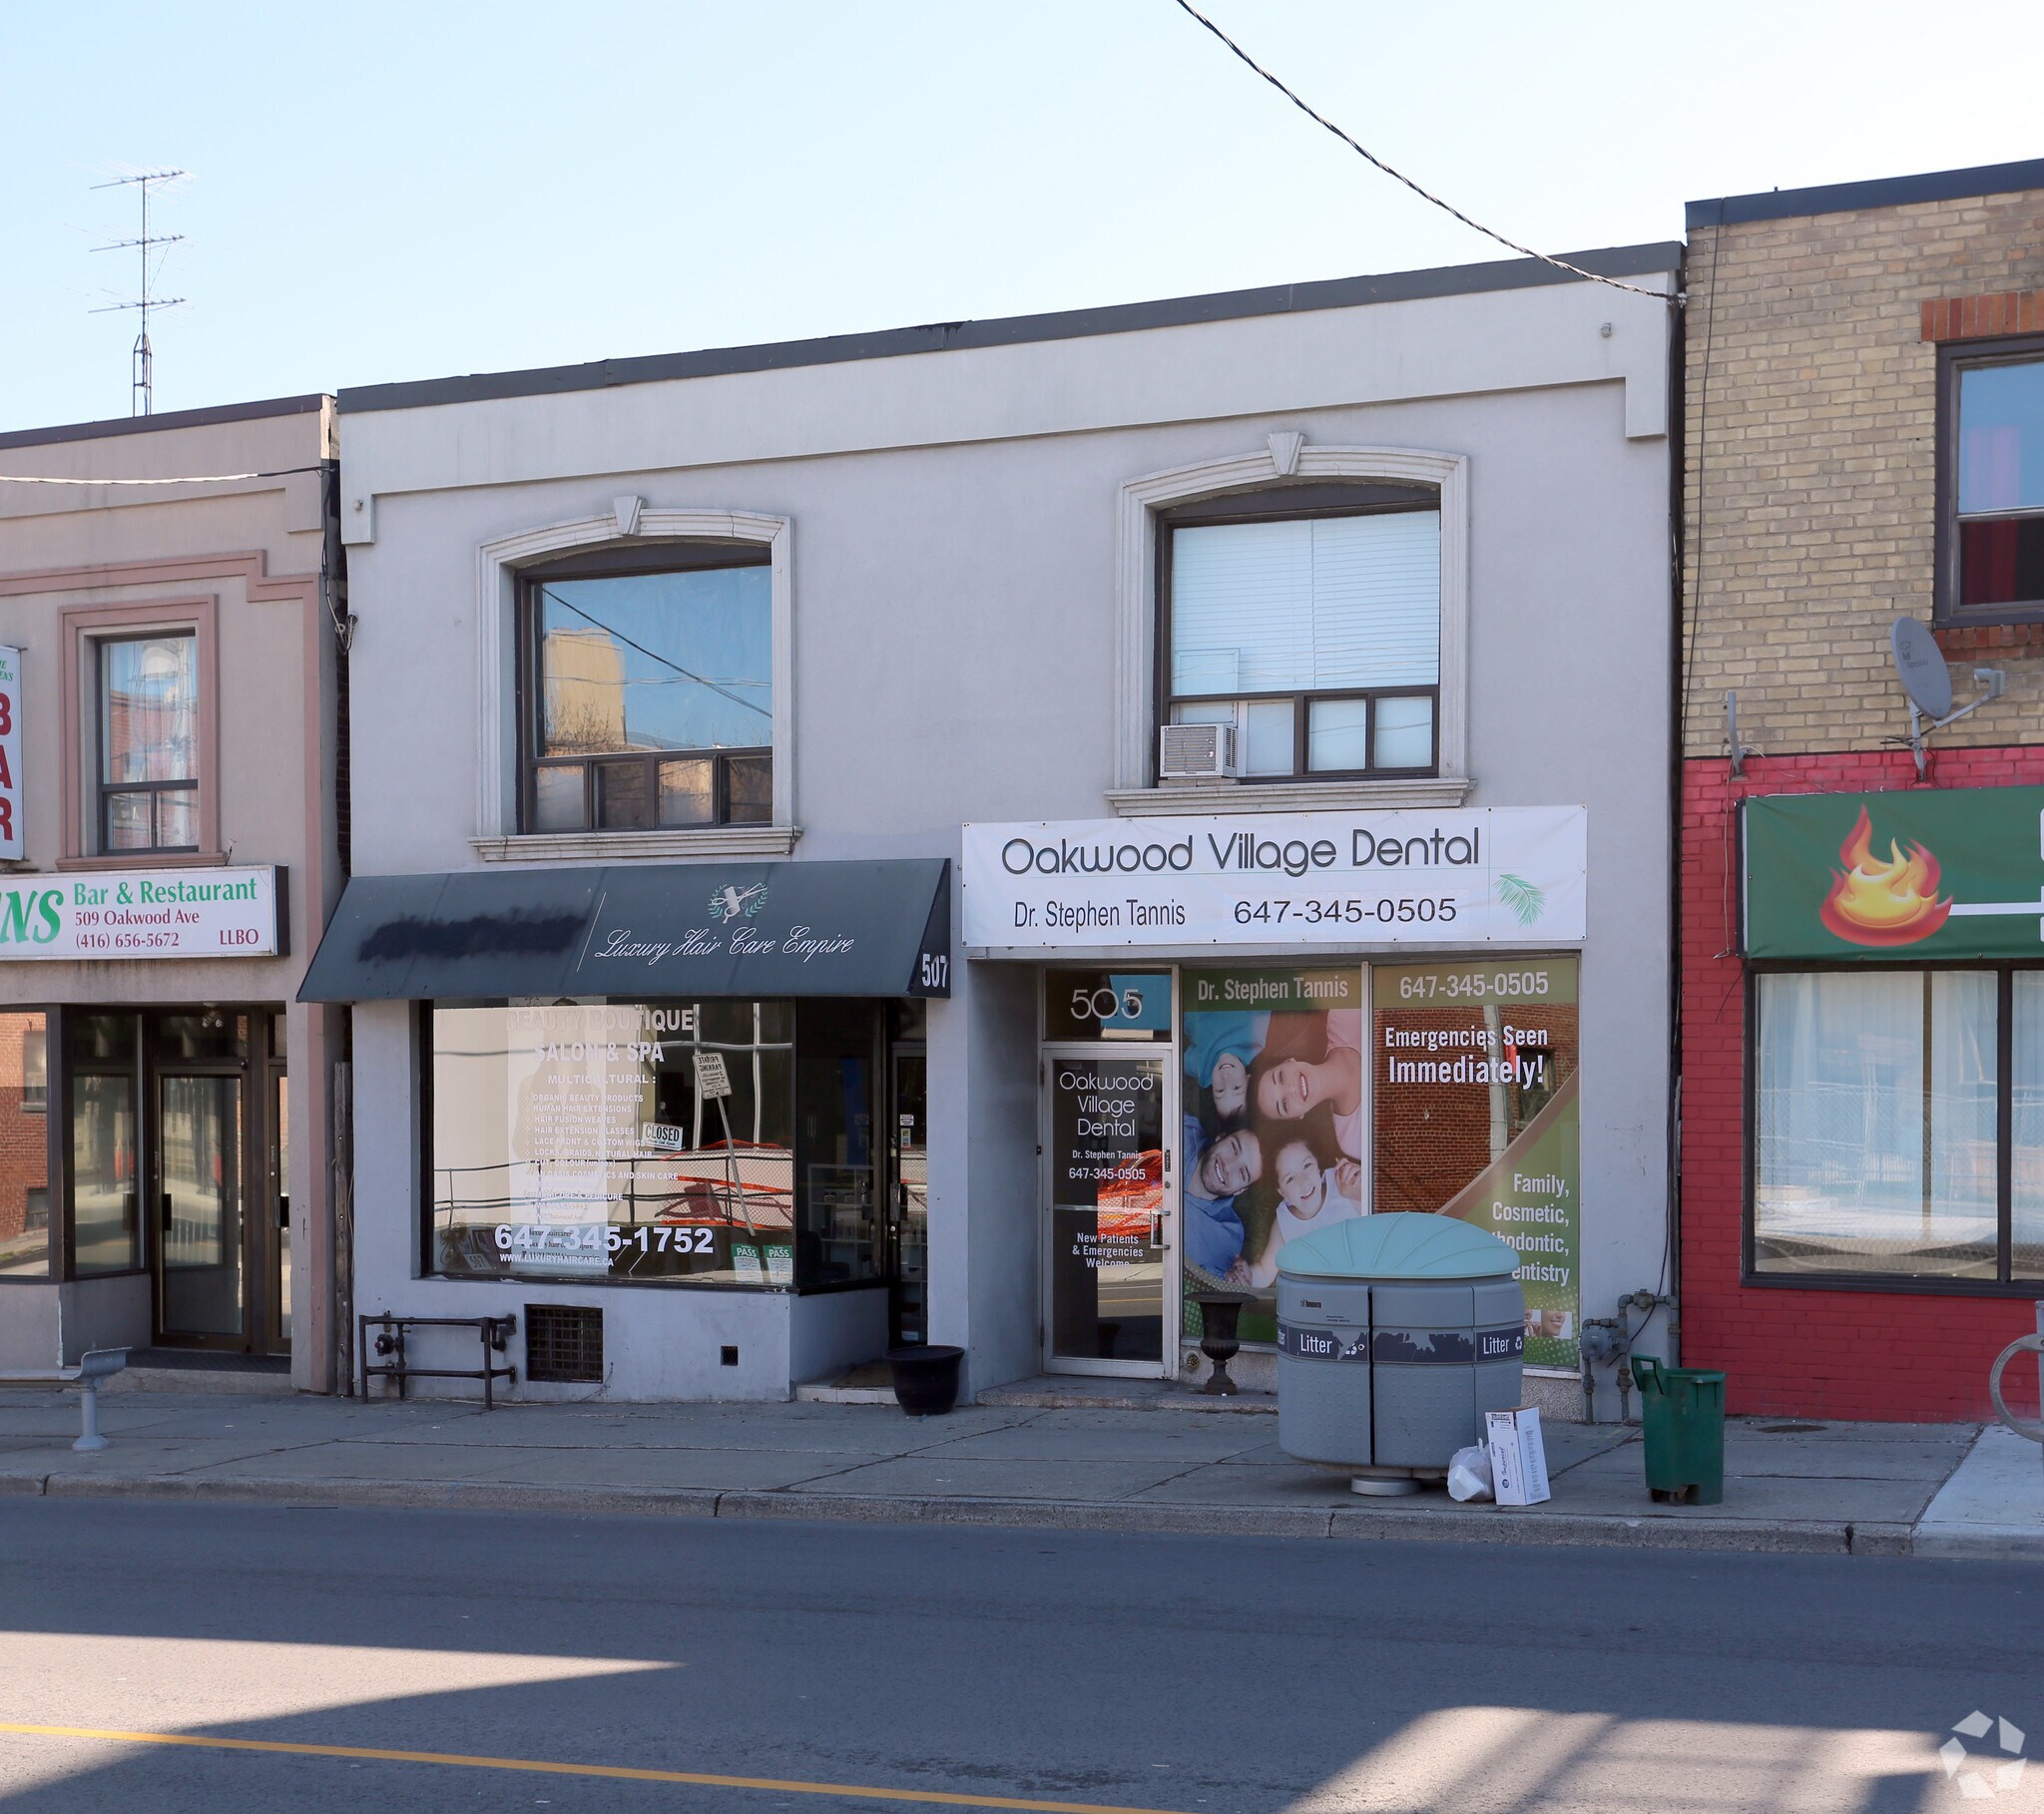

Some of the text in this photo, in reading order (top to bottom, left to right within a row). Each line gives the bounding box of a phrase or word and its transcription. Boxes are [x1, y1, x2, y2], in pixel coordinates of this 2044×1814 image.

[1001, 826, 1479, 878] Oakwood Village Dental
[74, 877, 257, 906] Bar & Restaurant
[0, 889, 64, 944] NS
[75, 908, 200, 927] 509 Oakwood Ave
[1014, 897, 1457, 933] Dr. Stephen Tannis 647-345-0505
[76, 932, 180, 949] (416) 656-5672
[220, 928, 259, 945] LLBO
[594, 924, 854, 966] Luxury Hair Care Empire
[920, 953, 950, 989] 507
[1198, 975, 1348, 1004] Dr. Stephen Tannis
[1399, 971, 1549, 999] 647-345-0505
[1070, 988, 1143, 1020] 505
[589, 1009, 694, 1032] BOUTIQUE
[1385, 1024, 1548, 1051] Emergencies Seen
[534, 1041, 665, 1064] SALON & SPA
[1059, 1072, 1154, 1091] Oakwood
[1389, 1054, 1544, 1090] Immediately!
[570, 1094, 599, 1103] BEAUTY
[600, 1094, 644, 1103] RODUCTS
[1077, 1095, 1136, 1118] Village
[599, 1127, 635, 1135] LASSES
[646, 1125, 680, 1142] CLOSED
[1077, 1118, 1135, 1136] Dental
[626, 1138, 646, 1147] WIGS
[1072, 1149, 1143, 1160] Dr. Stephen Tannis
[618, 1171, 634, 1180] AND
[1068, 1167, 1146, 1180] 647-345-0505
[1514, 1172, 1570, 1198] Family,
[1492, 1201, 1570, 1227] Cosmetic,
[494, 1223, 714, 1254] 647-345-1752
[1077, 1232, 1139, 1244] New Patients
[1492, 1231, 1569, 1256] hodontic,
[499, 1253, 614, 1267] WWW.LUXURYHAIRCARE.CA
[737, 1247, 758, 1258] PASS
[768, 1248, 789, 1258] PASS
[1072, 1244, 1144, 1258] & Emergencies
[1511, 1261, 1570, 1287] entistry
[1300, 1333, 1332, 1354] Litter
[1483, 1337, 1510, 1355] Litter
